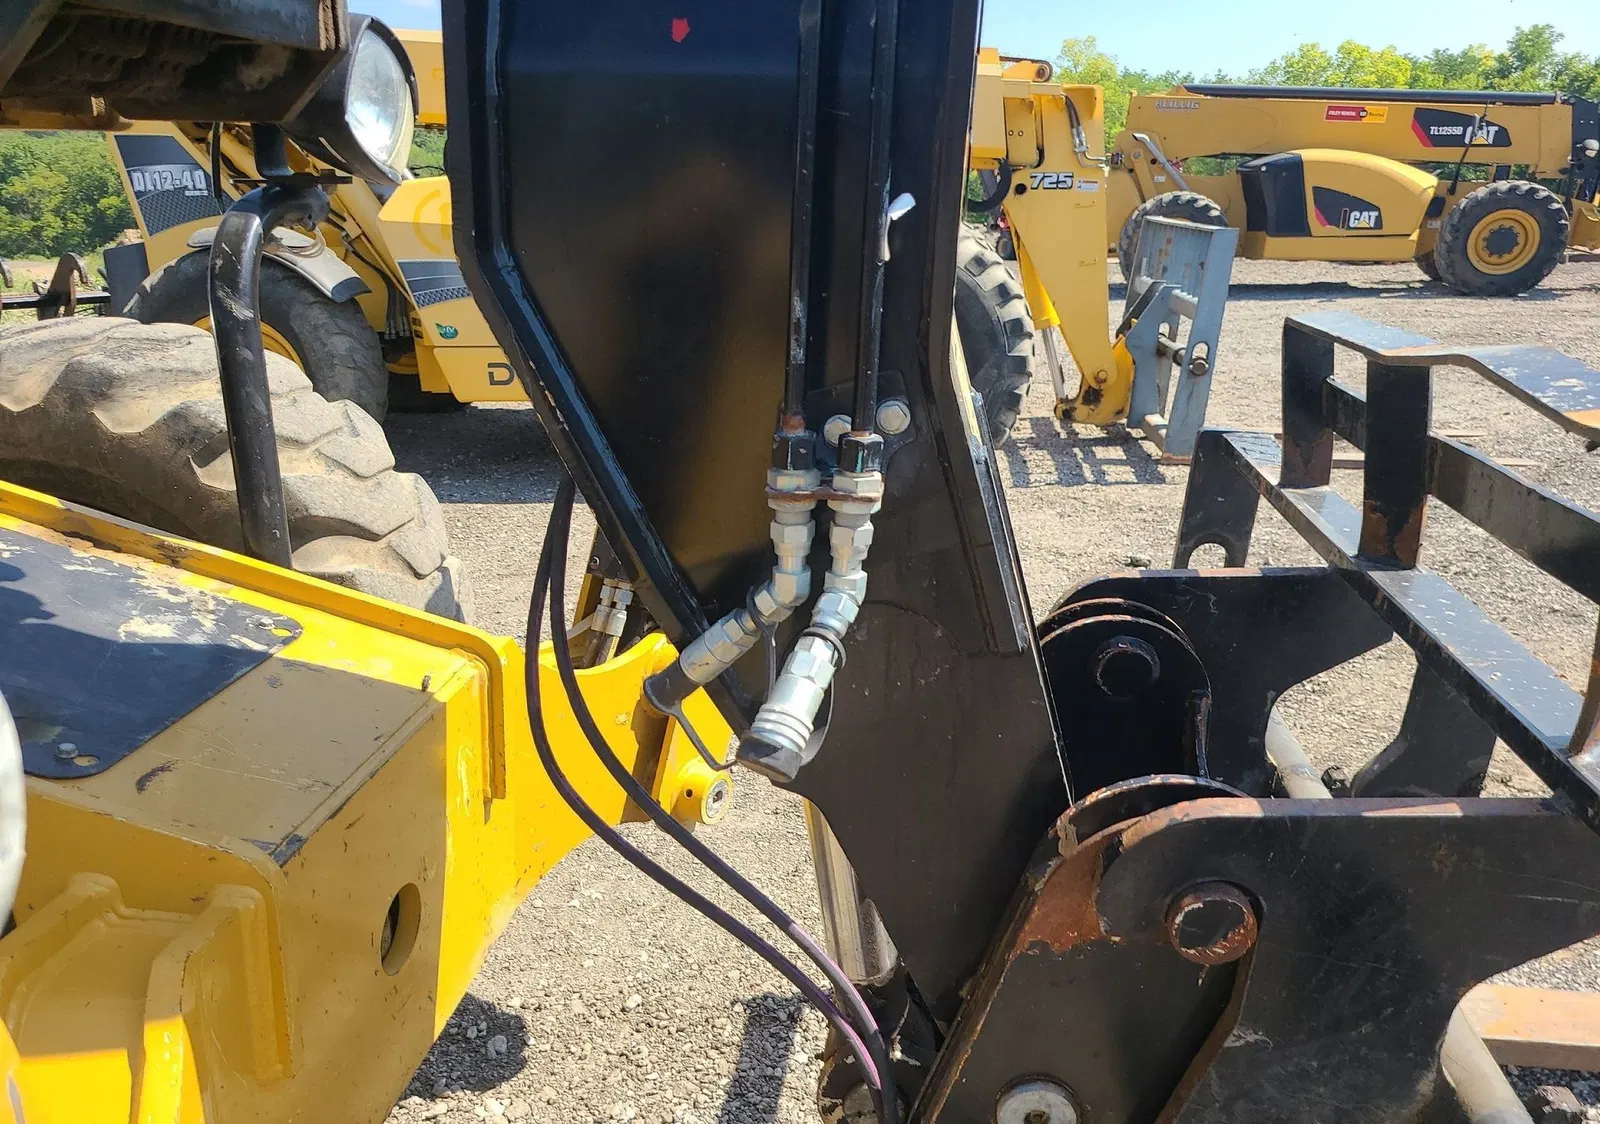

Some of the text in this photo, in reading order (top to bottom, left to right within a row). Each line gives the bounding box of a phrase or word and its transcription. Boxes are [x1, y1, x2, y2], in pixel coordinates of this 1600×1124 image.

[1429, 126, 1463, 135] TL1255D
[1030, 172, 1074, 189] 725
[1349, 210, 1379, 228] CAT
